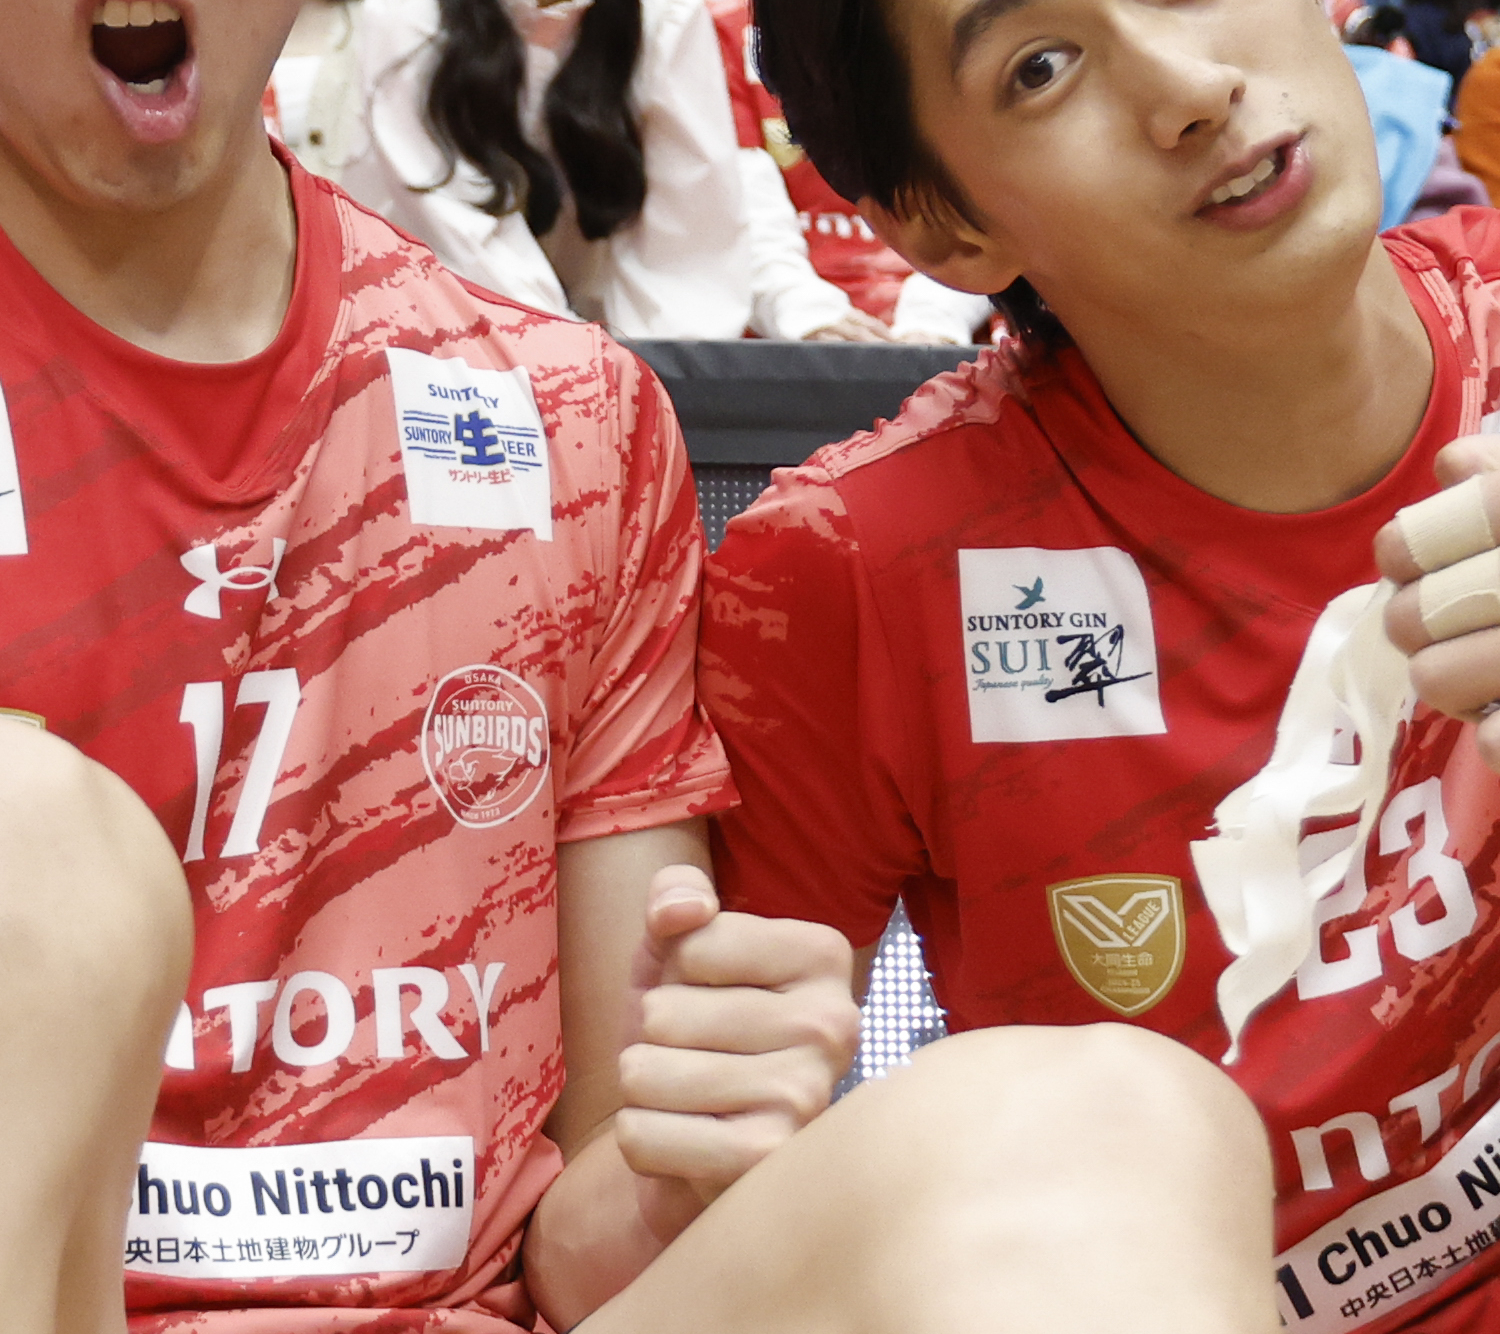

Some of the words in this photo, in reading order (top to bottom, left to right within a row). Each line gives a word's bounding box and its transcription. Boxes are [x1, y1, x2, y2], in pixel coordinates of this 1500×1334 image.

[405, 425, 452, 444] SUNTORY
[455, 409, 505, 466] 生
[967, 612, 1065, 631] SUNTORY
[1069, 612, 1107, 628] GIN
[464, 673, 502, 685] OSAKA
[971, 638, 1052, 675] SUI
[179, 668, 301, 862] 17
[434, 713, 543, 767] SUNBIRDS
[1297, 775, 1478, 1001] 23
[1122, 899, 1161, 941] LEAGUE
[130, 1163, 232, 1217] huo
[250, 1158, 464, 1217] Nittochi
[124, 1229, 420, 1265] 央日本土地建物グループ
[1317, 1200, 1452, 1286] Chuo
